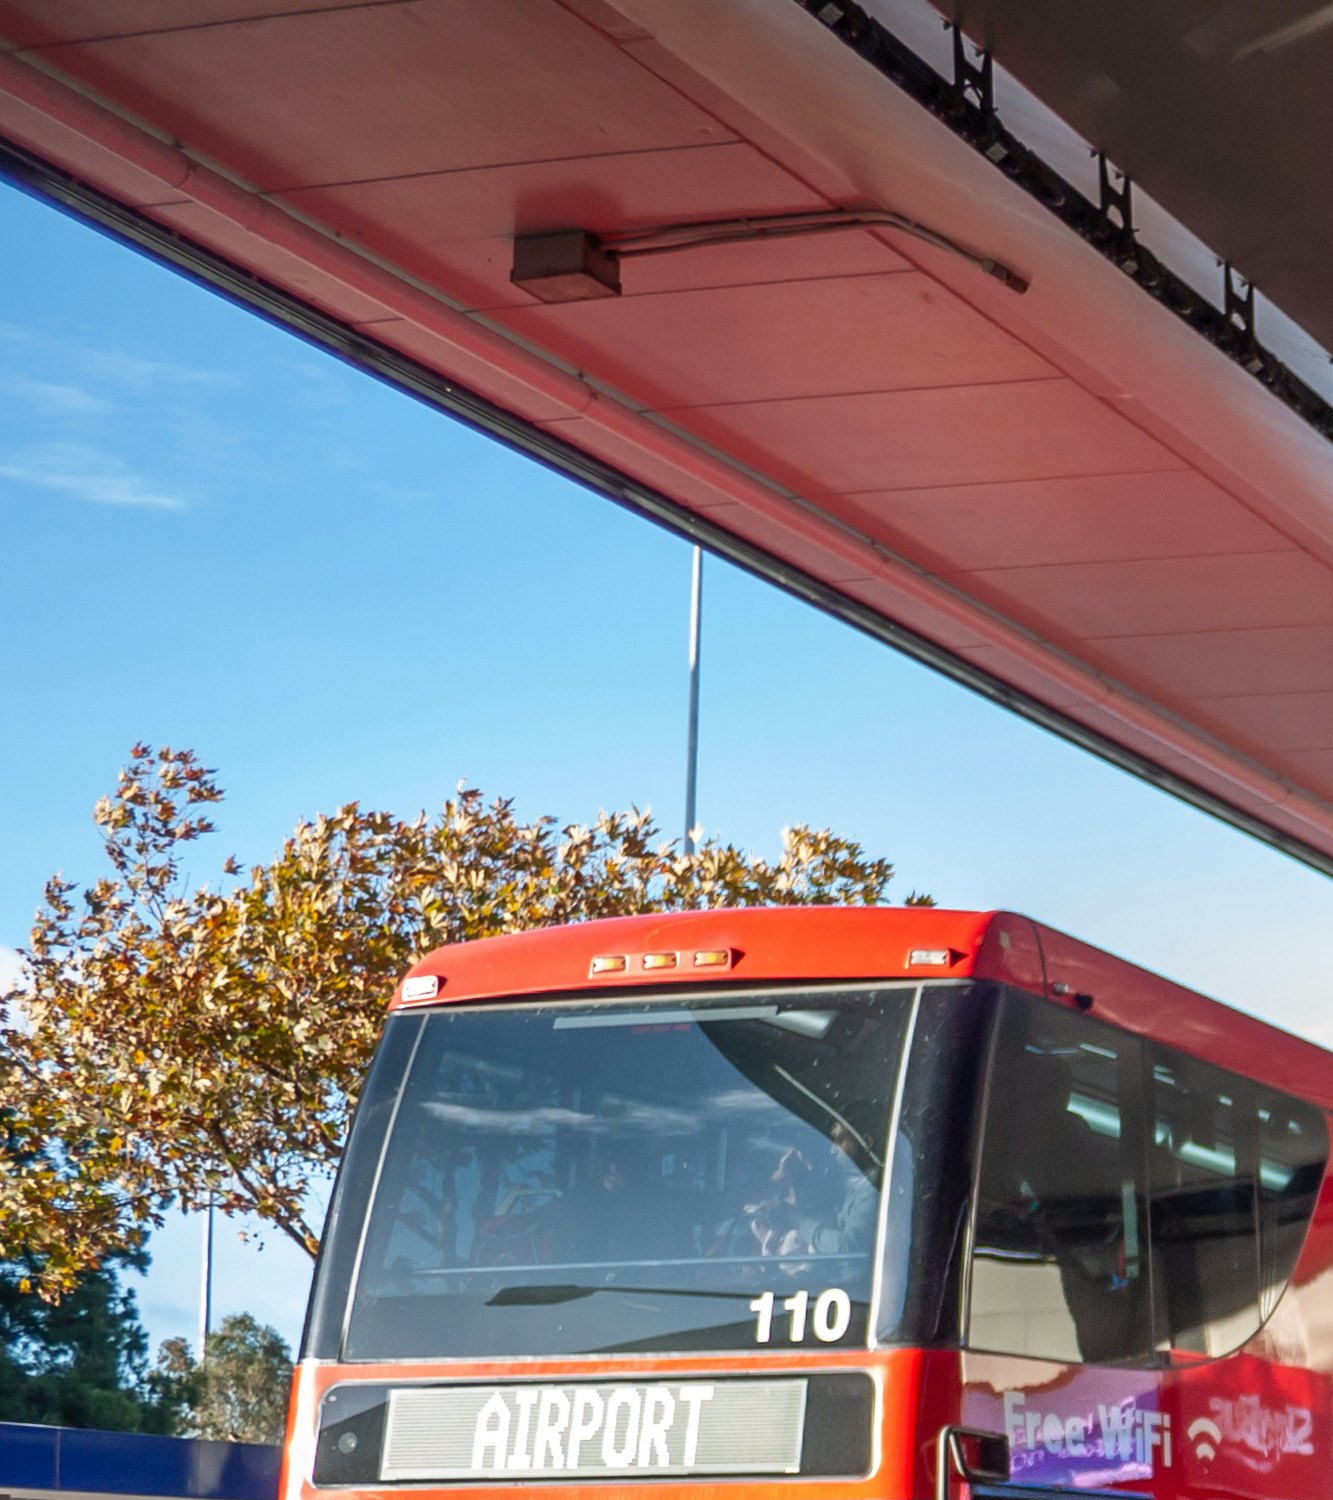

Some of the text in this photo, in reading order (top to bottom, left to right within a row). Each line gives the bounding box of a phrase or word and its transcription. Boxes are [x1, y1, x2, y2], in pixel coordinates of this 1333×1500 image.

[750, 1288, 852, 1343] 110
[471, 1385, 715, 1471] AIRPORT
[1004, 1390, 1086, 1457] Free
[1098, 1403, 1172, 1469] WiFi
